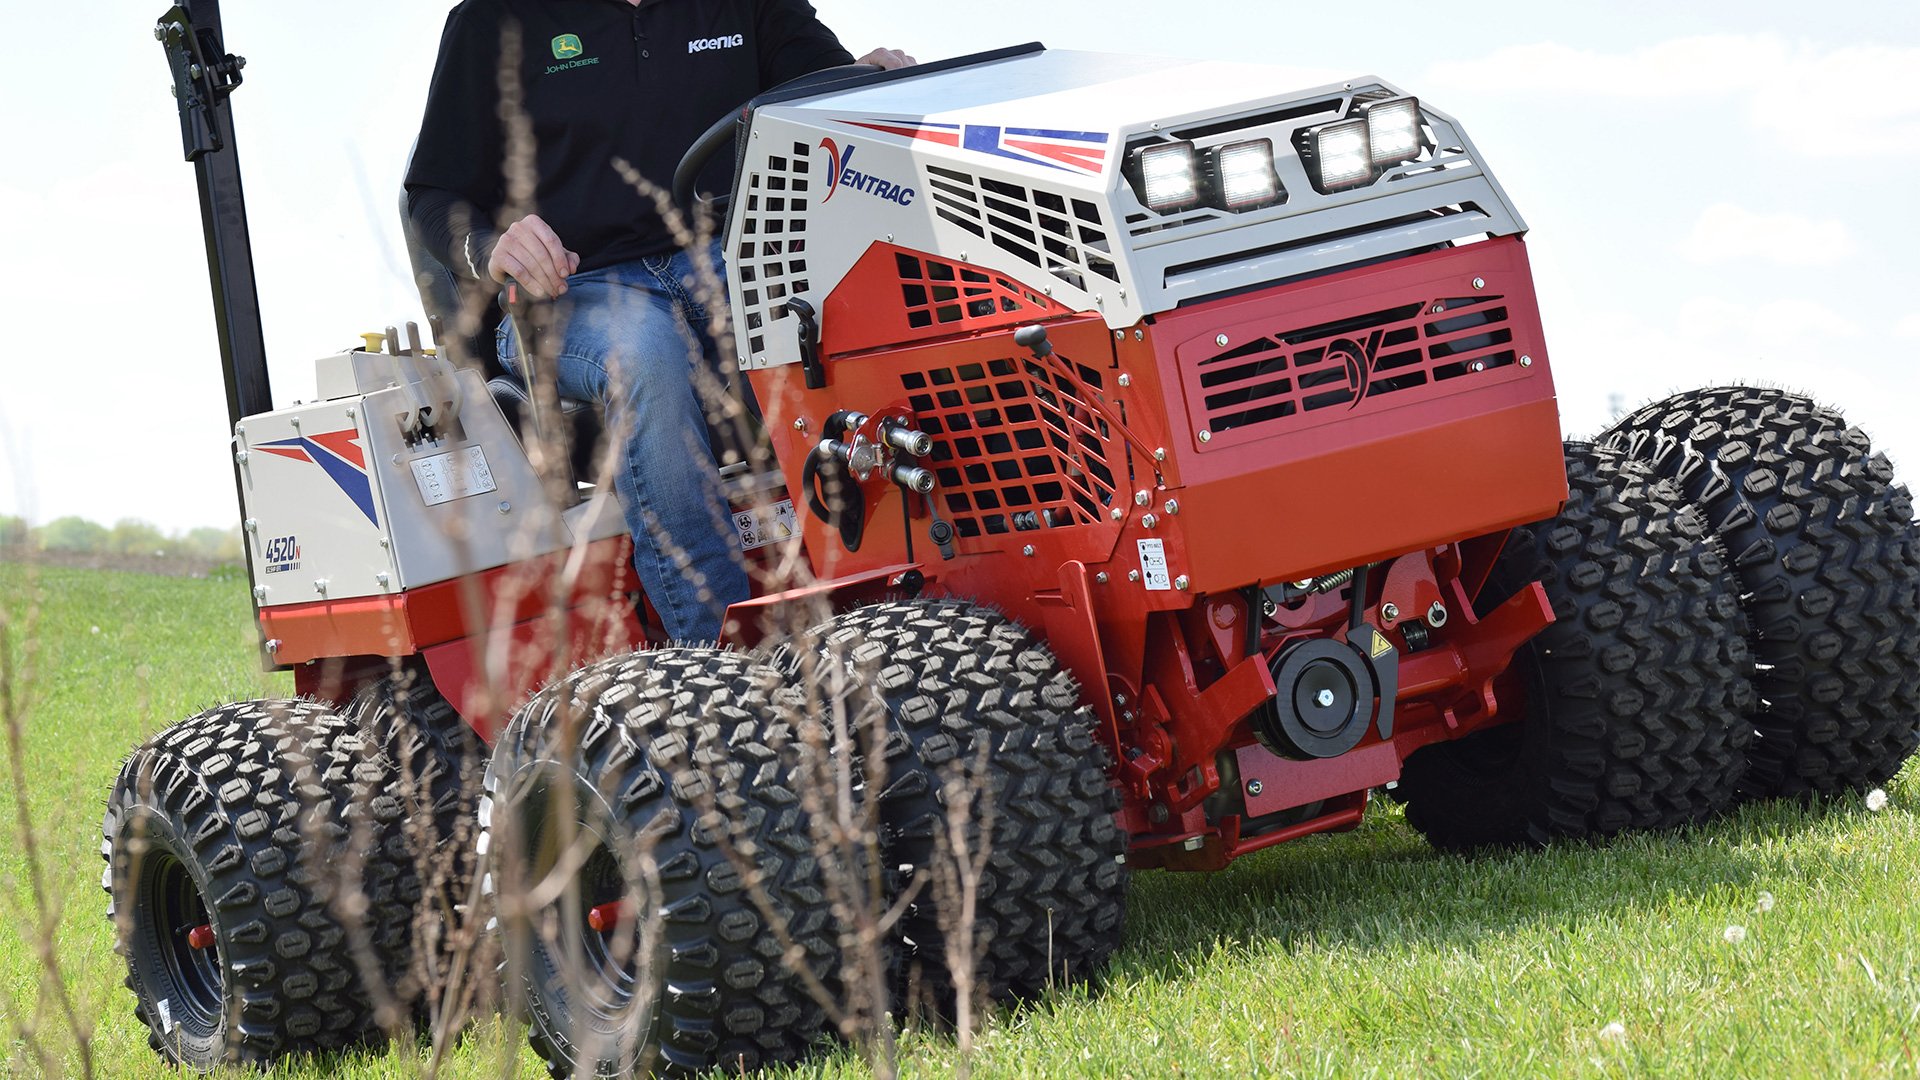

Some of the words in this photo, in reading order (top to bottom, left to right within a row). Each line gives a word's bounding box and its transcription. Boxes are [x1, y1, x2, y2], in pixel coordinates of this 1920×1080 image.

[545, 63, 569, 75] JOHN
[569, 57, 600, 68] DEERE
[818, 137, 915, 206] VENTRAC
